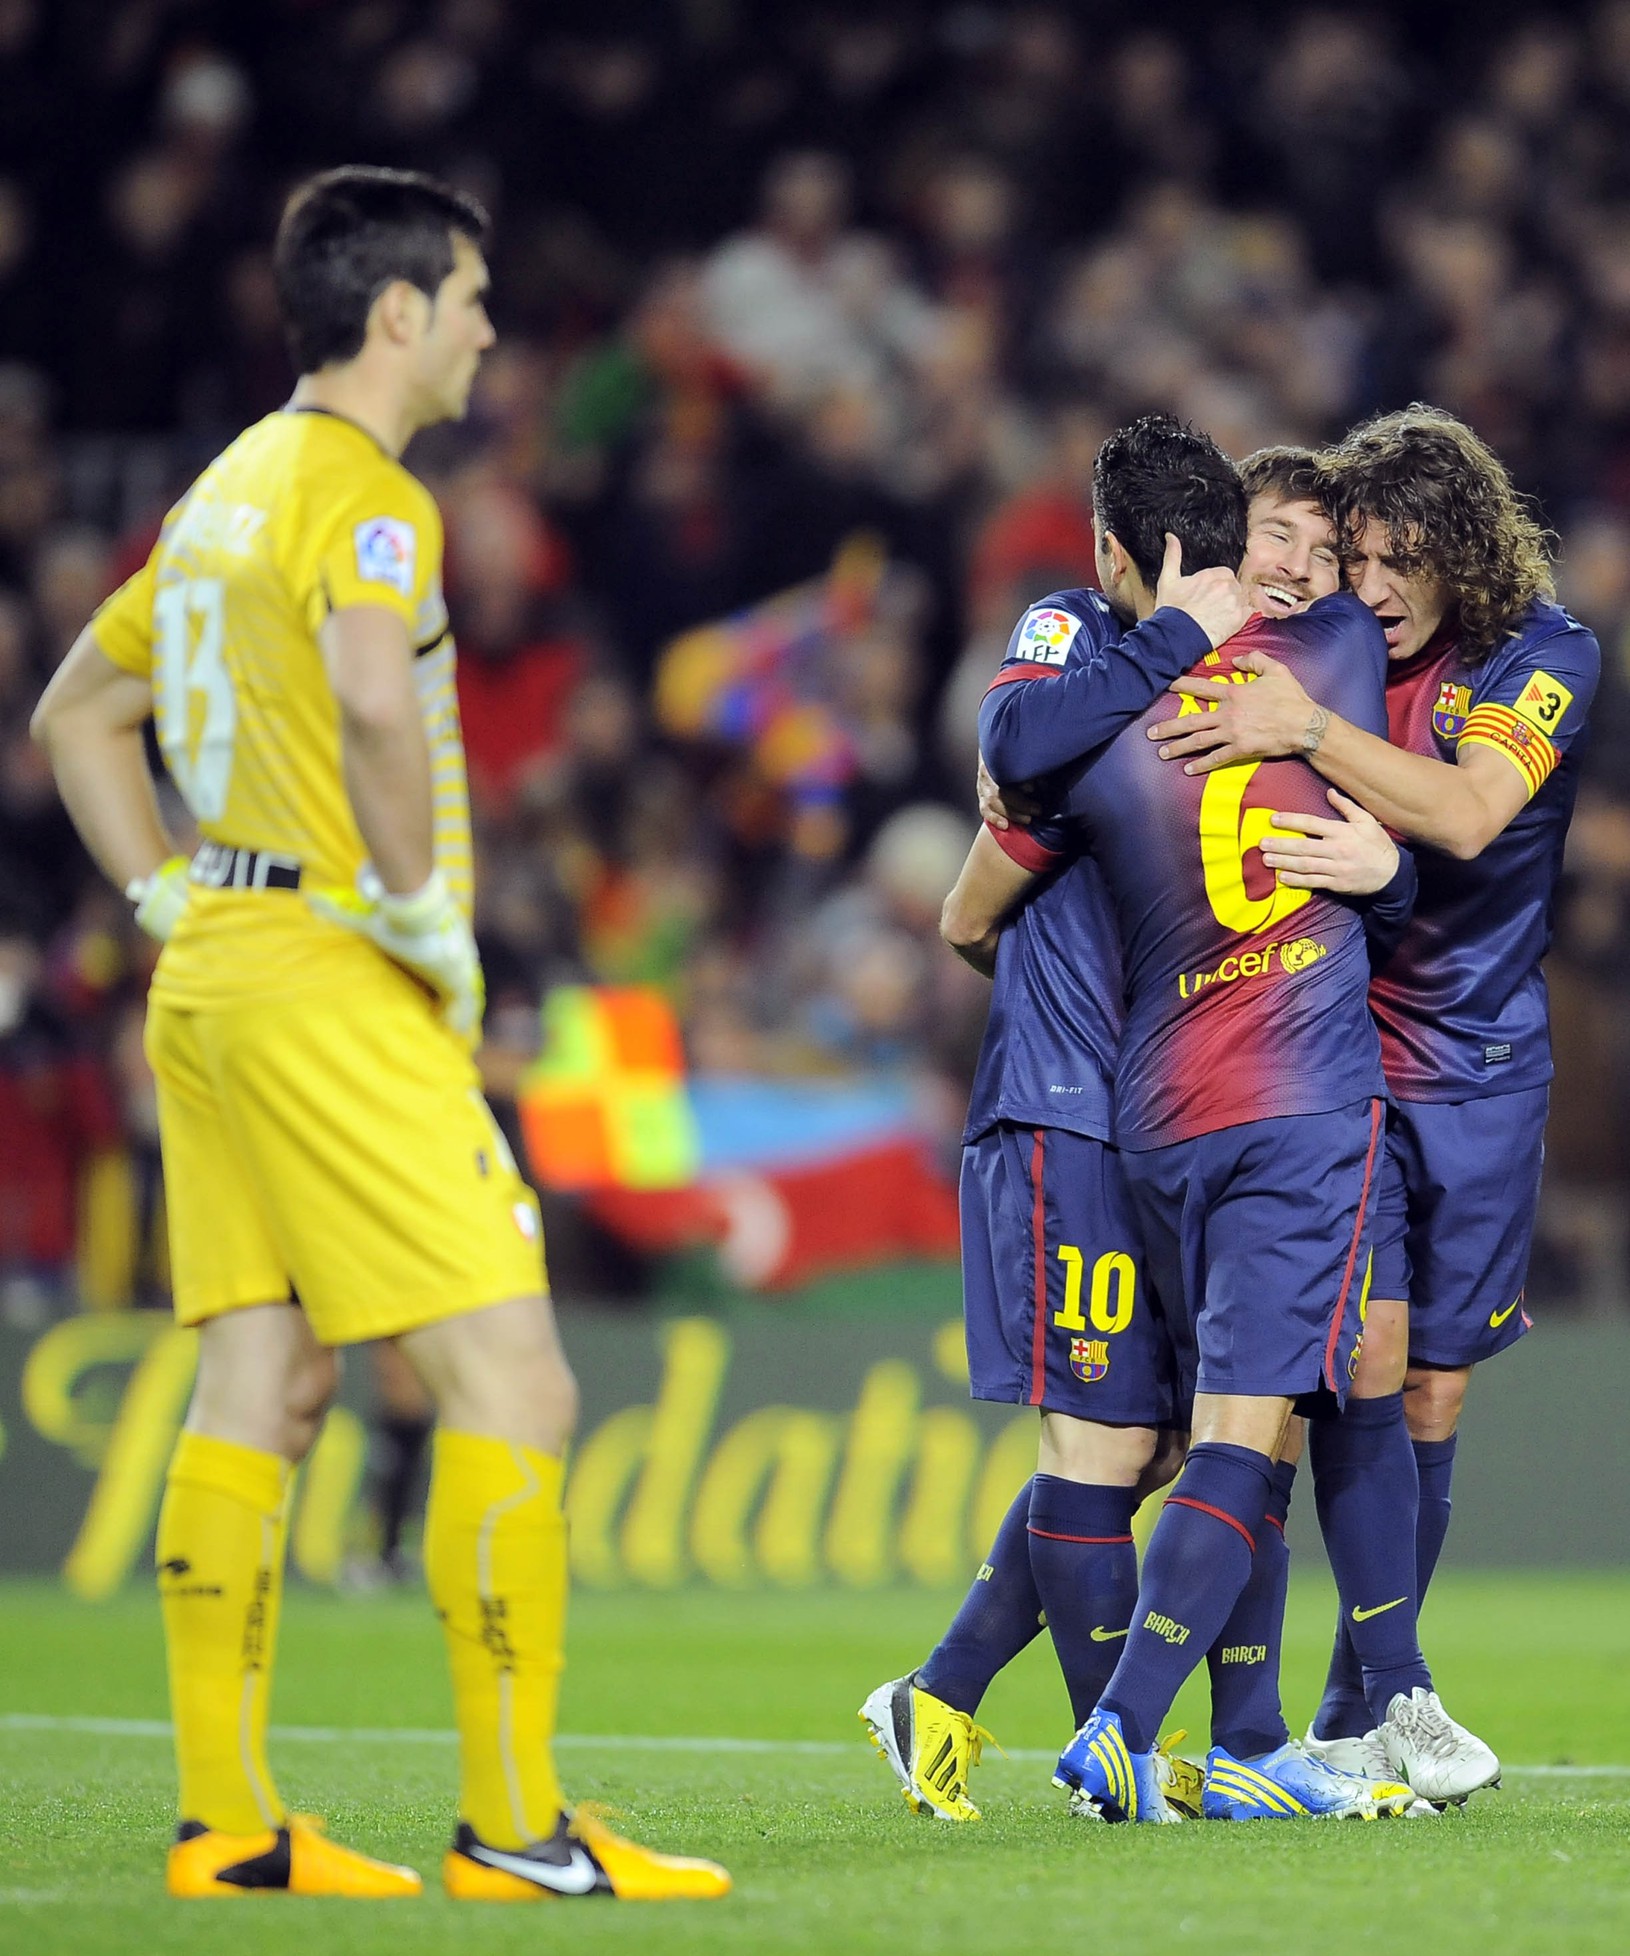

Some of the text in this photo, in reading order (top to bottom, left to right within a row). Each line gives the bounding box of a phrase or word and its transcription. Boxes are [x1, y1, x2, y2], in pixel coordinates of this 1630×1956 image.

[1538, 692, 1561, 721] 3
[1199, 757, 1312, 935] 6
[1050, 1085, 1083, 1094] DRI-FIT
[1054, 1244, 1136, 1334] 10
[1143, 1610, 1191, 1646] BARÇA
[1221, 1644, 1267, 1665] BARÇA
